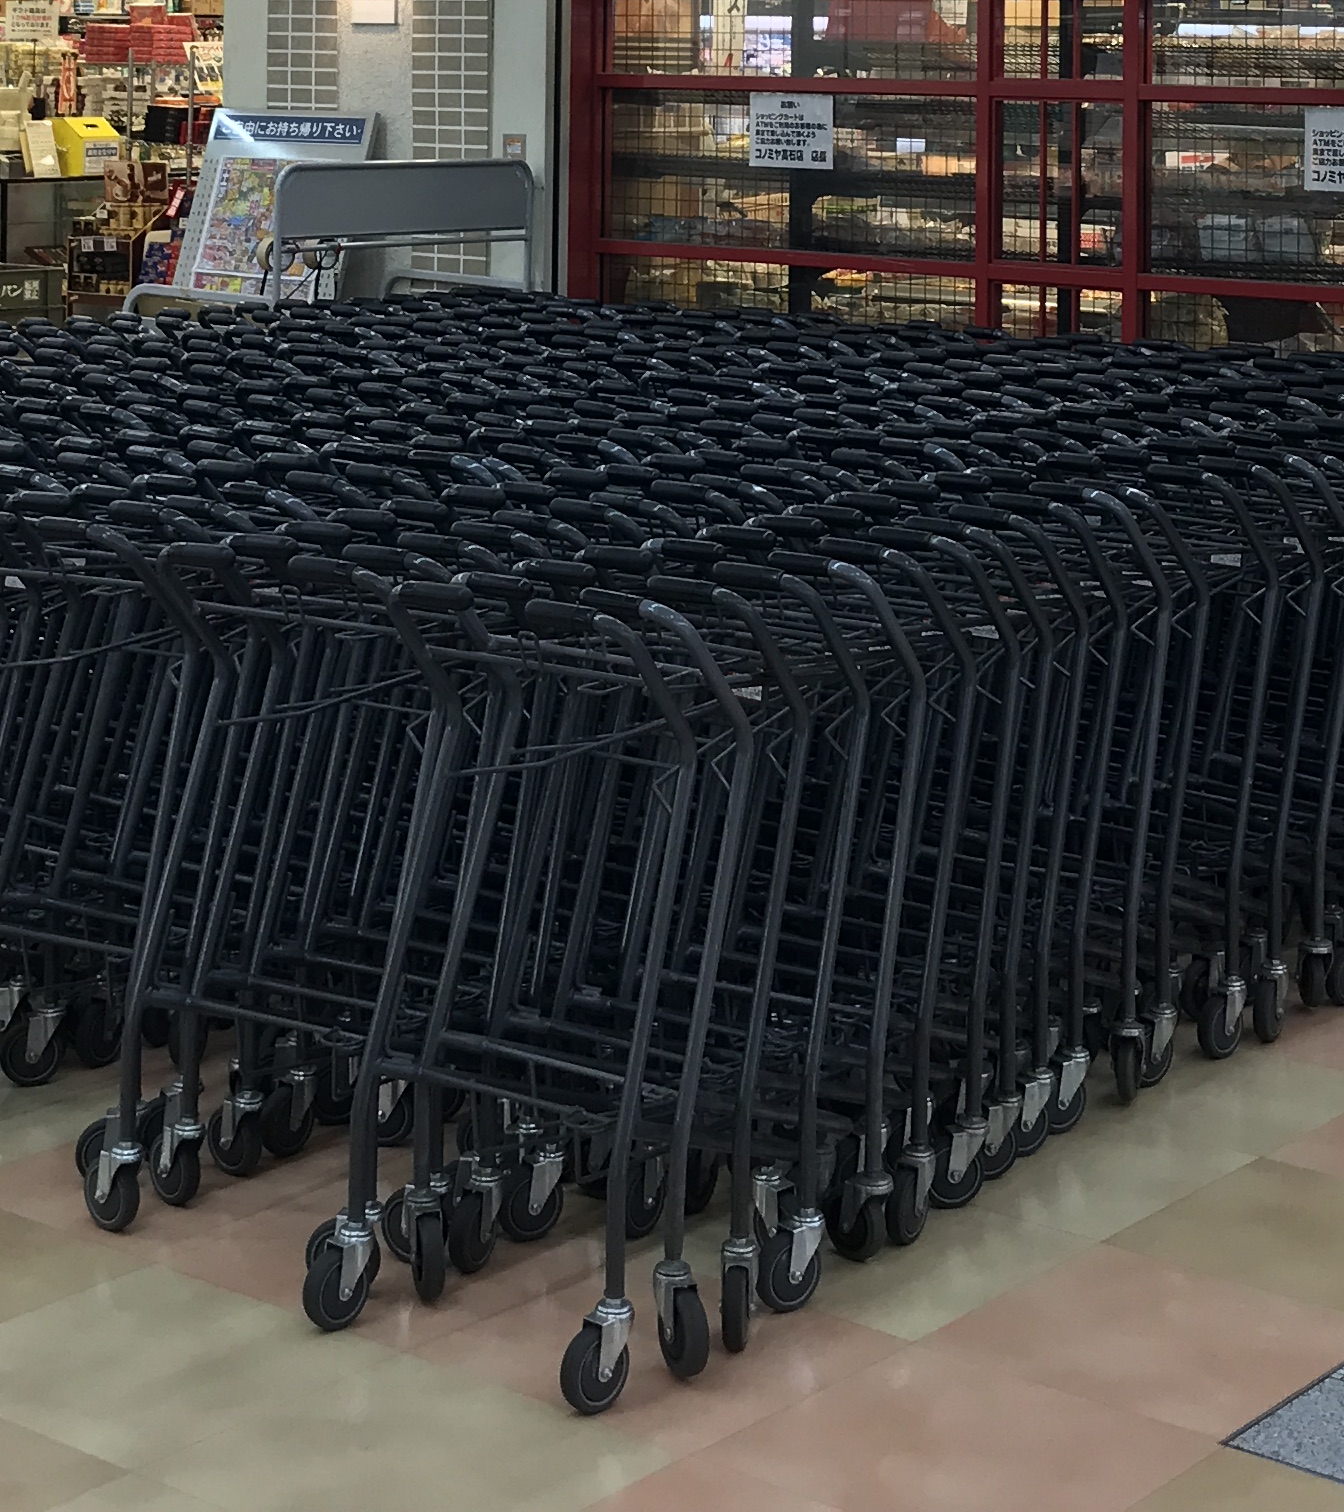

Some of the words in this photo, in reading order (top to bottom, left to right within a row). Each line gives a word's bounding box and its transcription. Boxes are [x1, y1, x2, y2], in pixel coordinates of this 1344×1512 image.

[756, 113, 804, 121] ショッピングカートは
